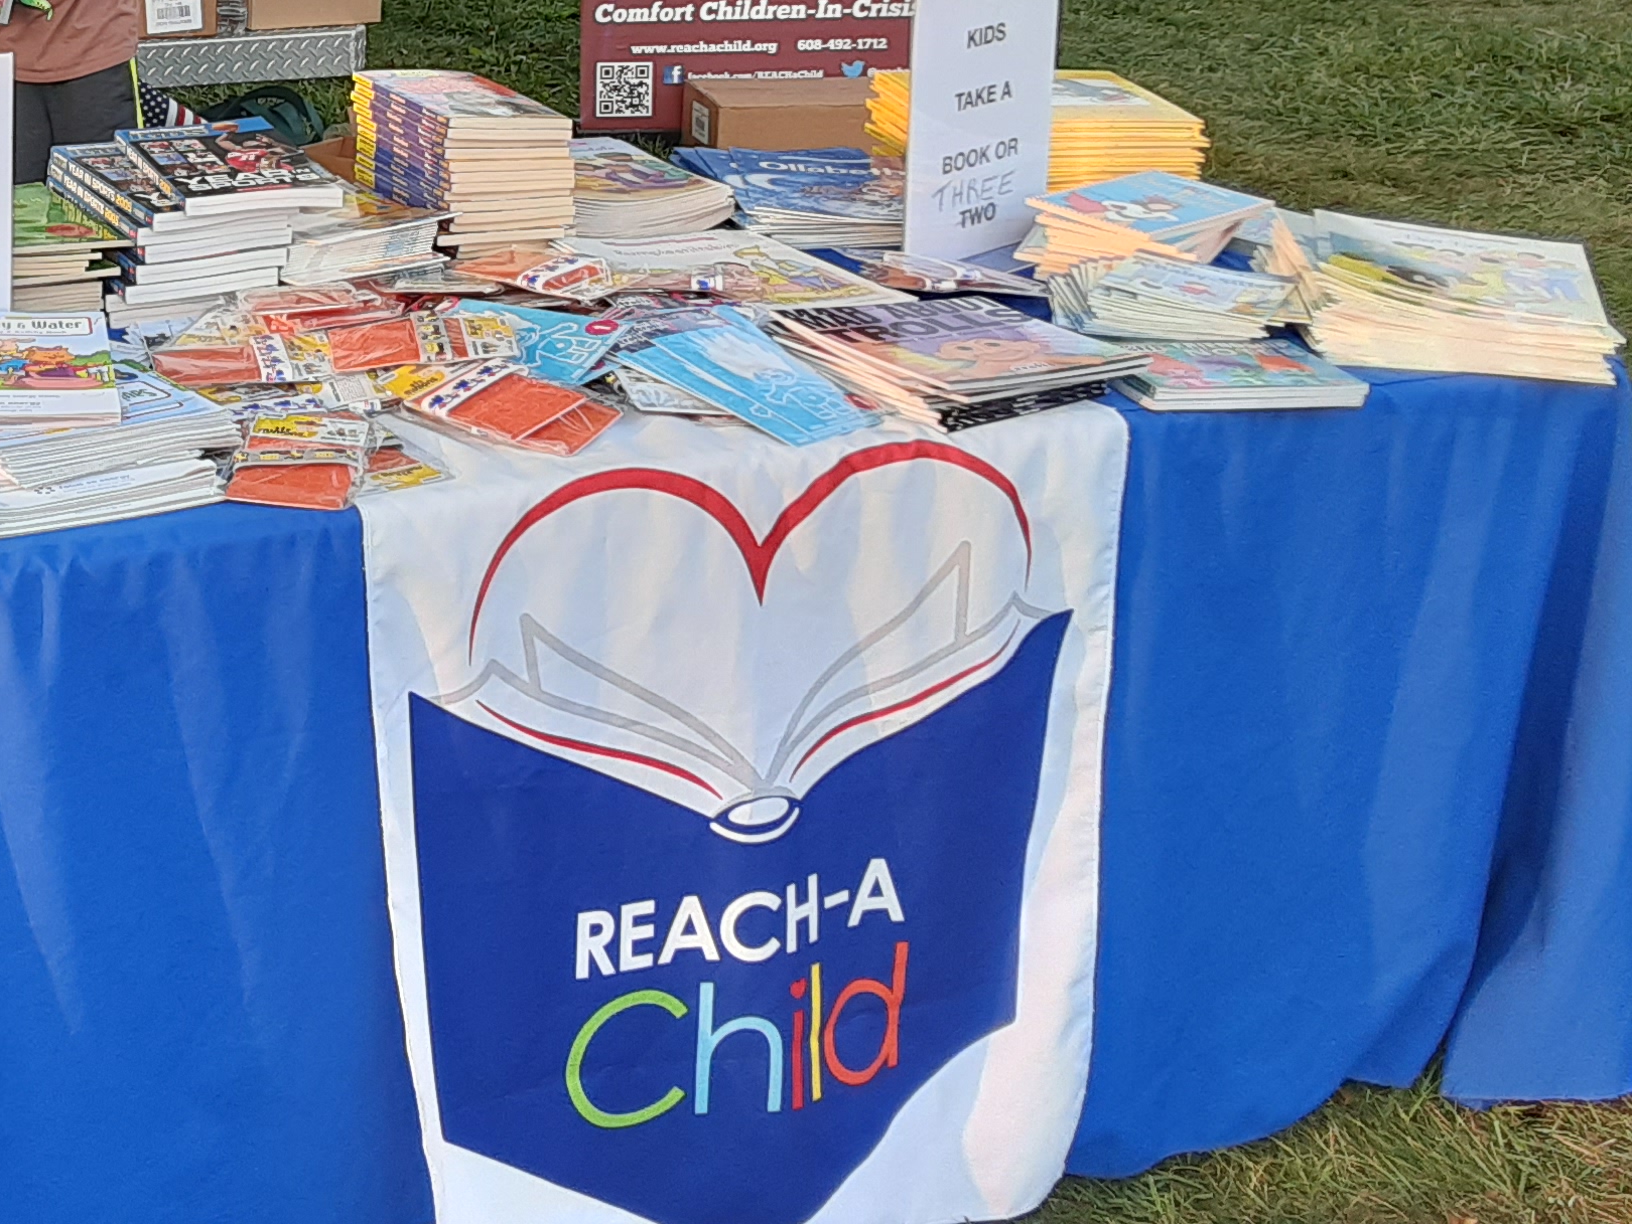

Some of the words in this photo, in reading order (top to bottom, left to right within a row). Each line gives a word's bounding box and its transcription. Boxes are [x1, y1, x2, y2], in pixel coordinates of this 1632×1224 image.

[594, 2, 694, 23] Comfort
[630, 40, 778, 55] www.reachachild.org
[797, 38, 888, 51] 608-492-1712
[966, 22, 1007, 49] KIDS
[955, 83, 997, 111] TAKE
[1000, 80, 1013, 100] A
[942, 145, 991, 175] BOOK
[994, 137, 1019, 160] OR
[174, 169, 290, 185] YEAR
[187, 173, 321, 192] SPORTS
[931, 170, 1017, 212] THREE
[959, 201, 997, 228] TWO
[885, 296, 1000, 320] ABOUT
[31, 317, 83, 330] Water
[820, 307, 1035, 343] TROLLS
[573, 857, 906, 981] REACH-A
[563, 941, 908, 1130] Child
